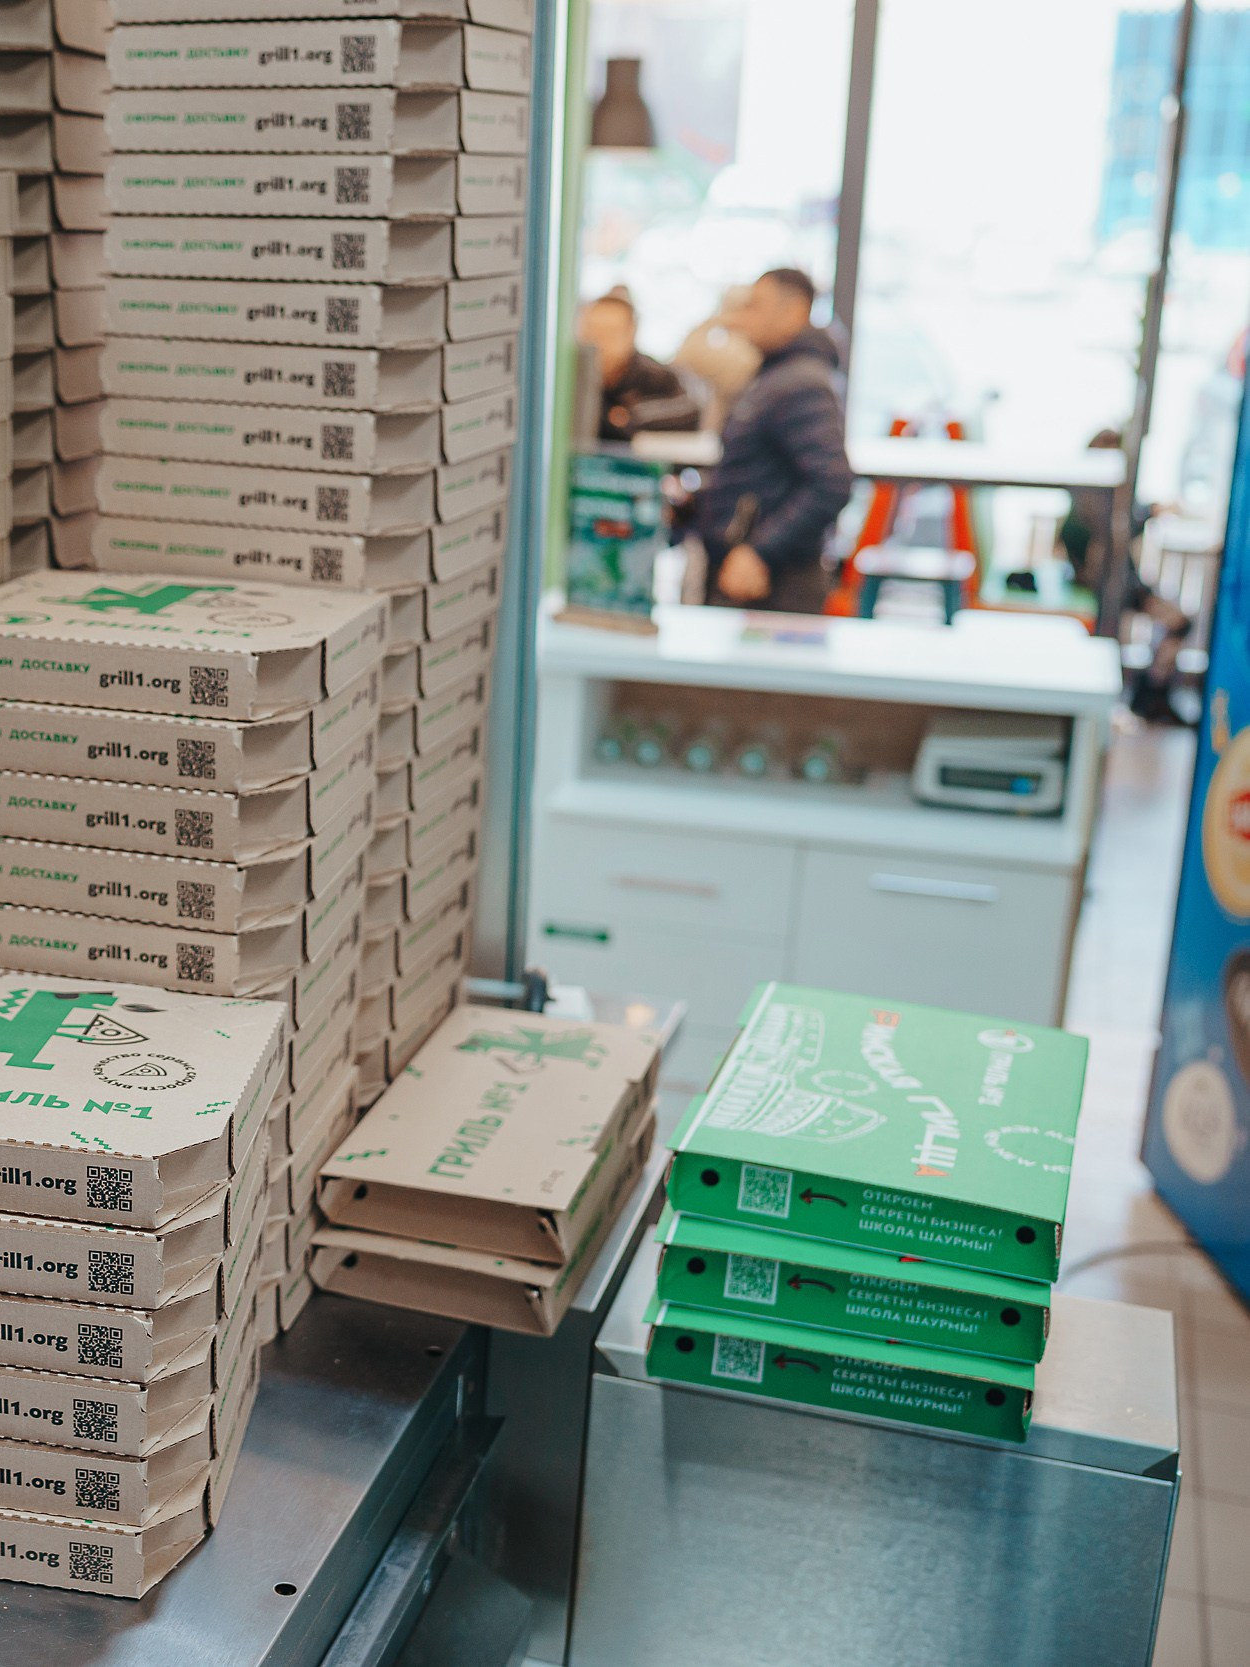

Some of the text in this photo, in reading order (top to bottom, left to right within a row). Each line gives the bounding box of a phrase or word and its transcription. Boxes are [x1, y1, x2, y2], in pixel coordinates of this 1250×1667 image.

[19, 658, 91, 674] ДОСТАВКУ
[99, 670, 181, 695] grill1.org
[8, 729, 79, 746] ДОСТАВКУ
[87, 741, 169, 767] grill1.org
[6, 795, 78, 813] ДОСТАВКУ
[85, 810, 167, 836] grill1.org
[9, 866, 79, 884] ДОСТАВКУ
[87, 881, 169, 907] grill1.org
[8, 934, 78, 954] ДОСТАВКУ
[87, 944, 168, 969] grill1.org
[83, 1099, 153, 1121] №1
[426, 1114, 506, 1180] ГРИЛЬ
[863, 1189, 933, 1210] ОТКРОЕМ
[858, 1218, 994, 1252] ШКОЛА ШАУРМЫ!
[861, 1203, 1003, 1239] СЕКРЕТЫ БИЗНЕСА!
[845, 1303, 979, 1335] ШКОЛА ШАУРМЫ!
[847, 1288, 989, 1321] СЕКРЕТЫ БИЗНЕСА!
[830, 1382, 963, 1415] ШКОЛА ШАУРМЫ!
[832, 1367, 972, 1401] СЕКРЕТЫ БИЗНЕСА!
